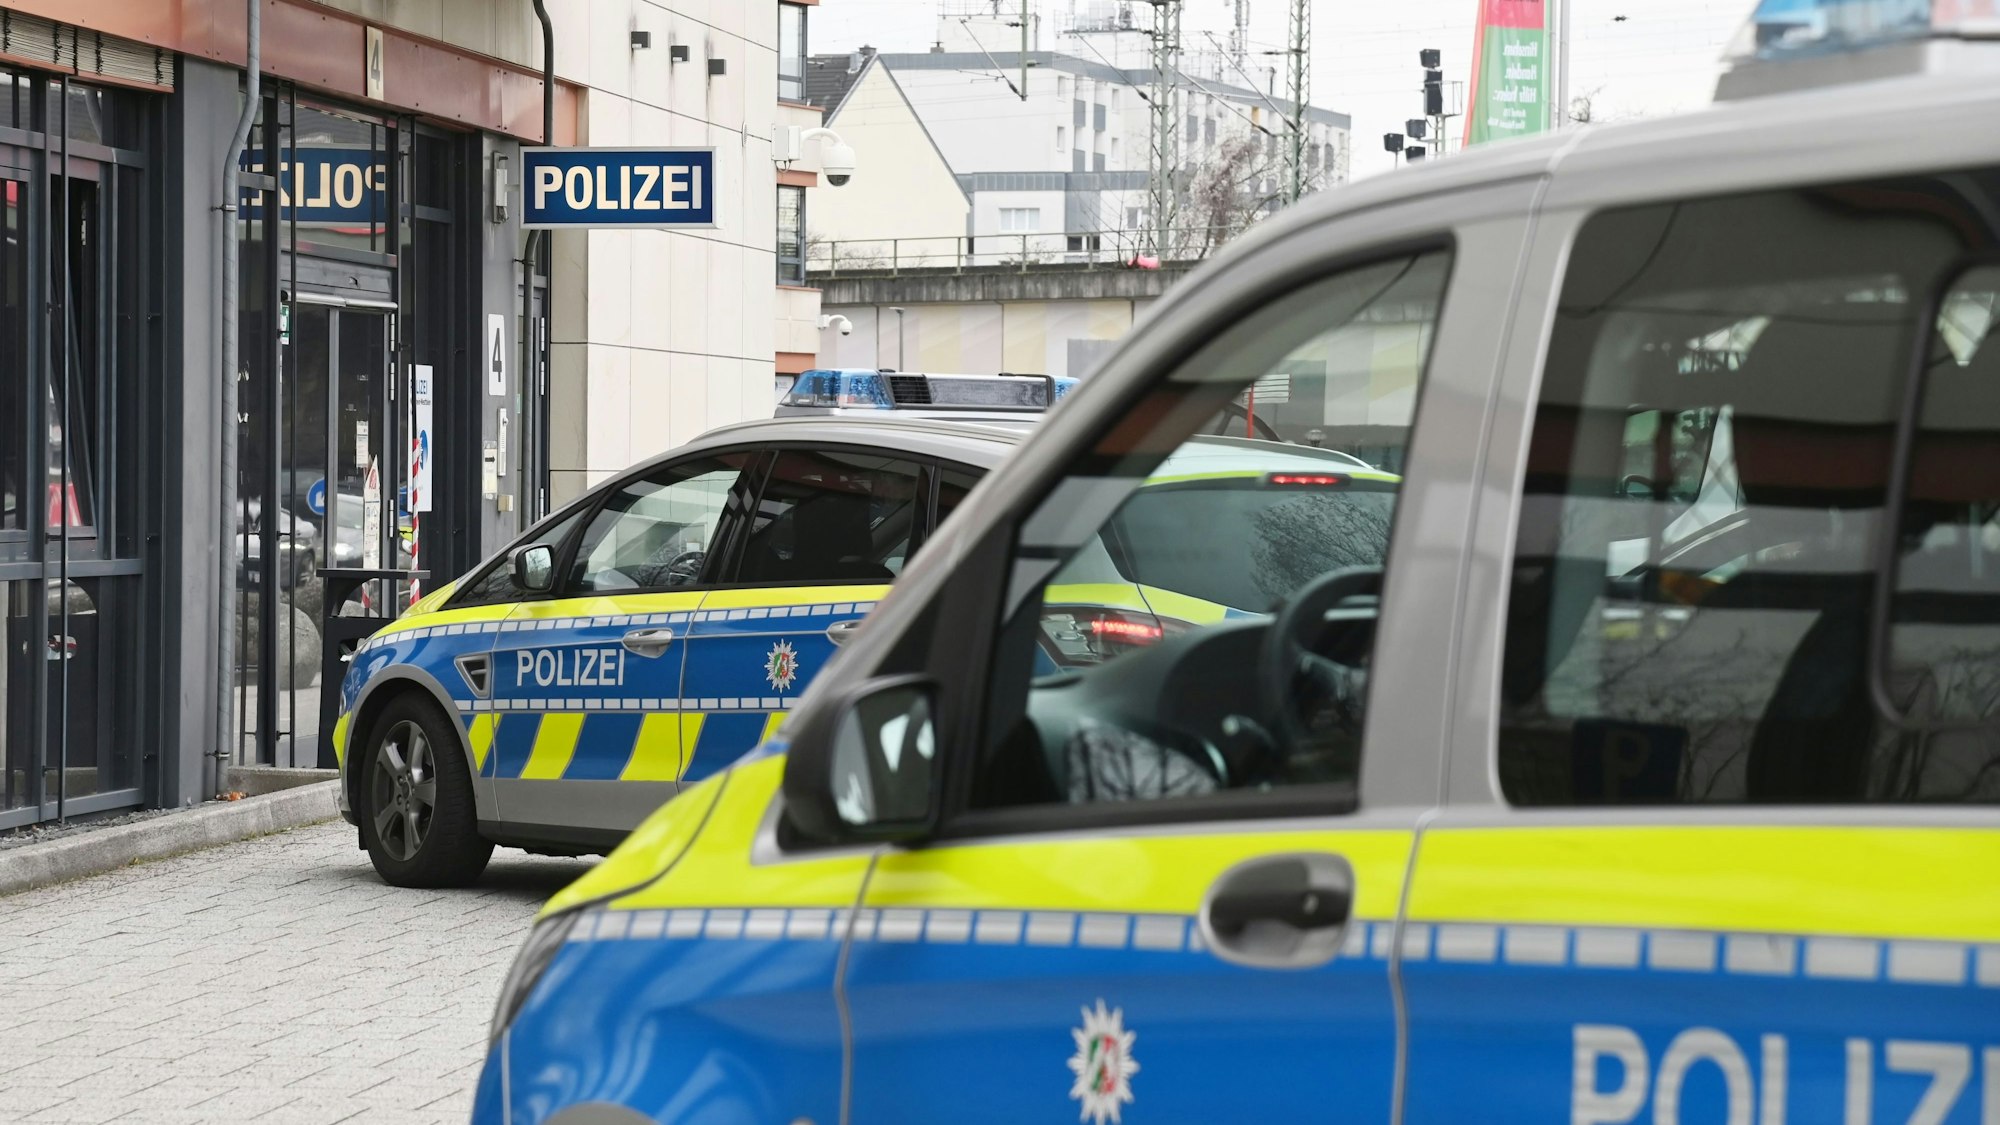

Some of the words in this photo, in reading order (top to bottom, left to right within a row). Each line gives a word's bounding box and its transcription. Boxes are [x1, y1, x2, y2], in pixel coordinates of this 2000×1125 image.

[370, 39, 381, 91] 4
[534, 165, 702, 210] POLIZEI
[492, 327, 502, 383] 4
[516, 648, 625, 687] POLIZEI
